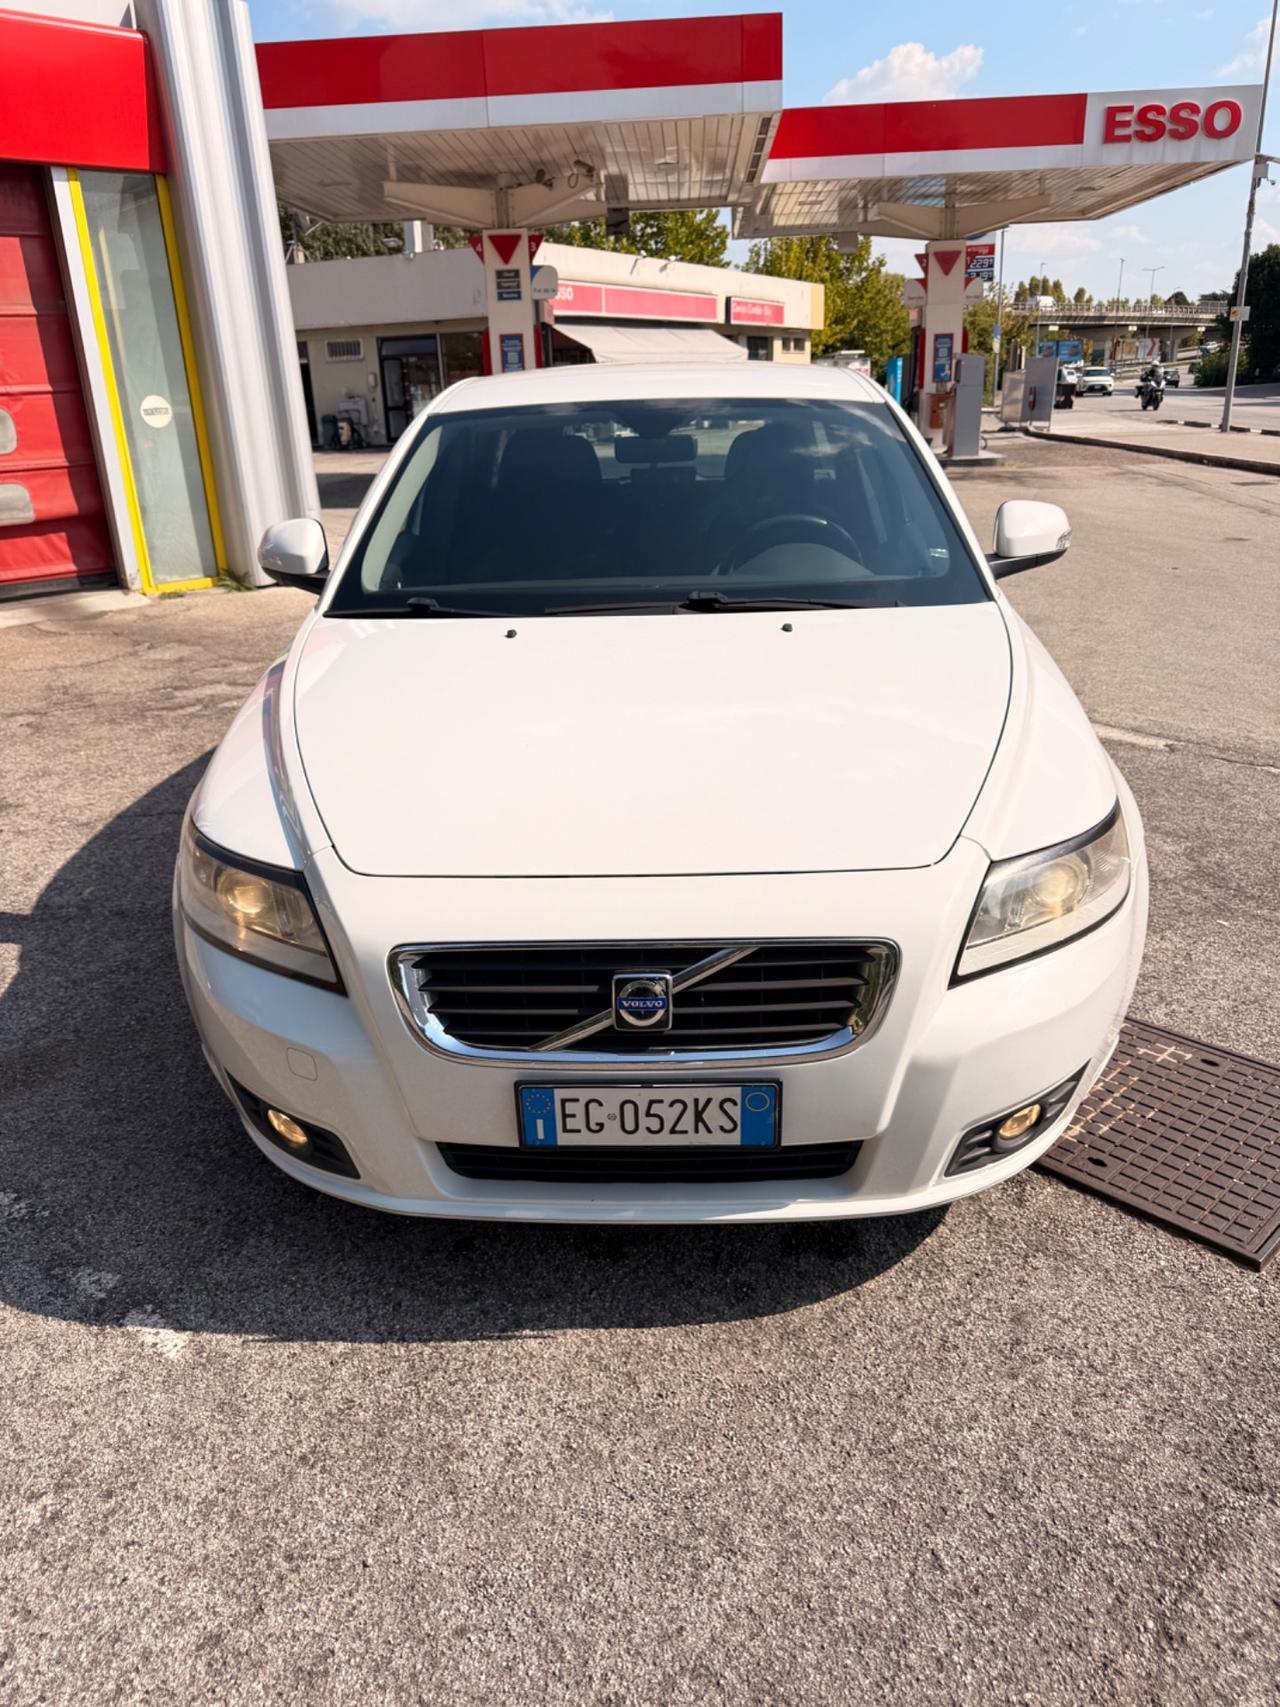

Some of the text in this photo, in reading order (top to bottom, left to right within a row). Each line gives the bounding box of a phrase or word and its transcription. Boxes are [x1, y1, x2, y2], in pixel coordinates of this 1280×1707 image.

[1103, 100, 1243, 144] ESSO
[530, 242, 537, 252] 3
[622, 1000, 663, 1008] VOLVO
